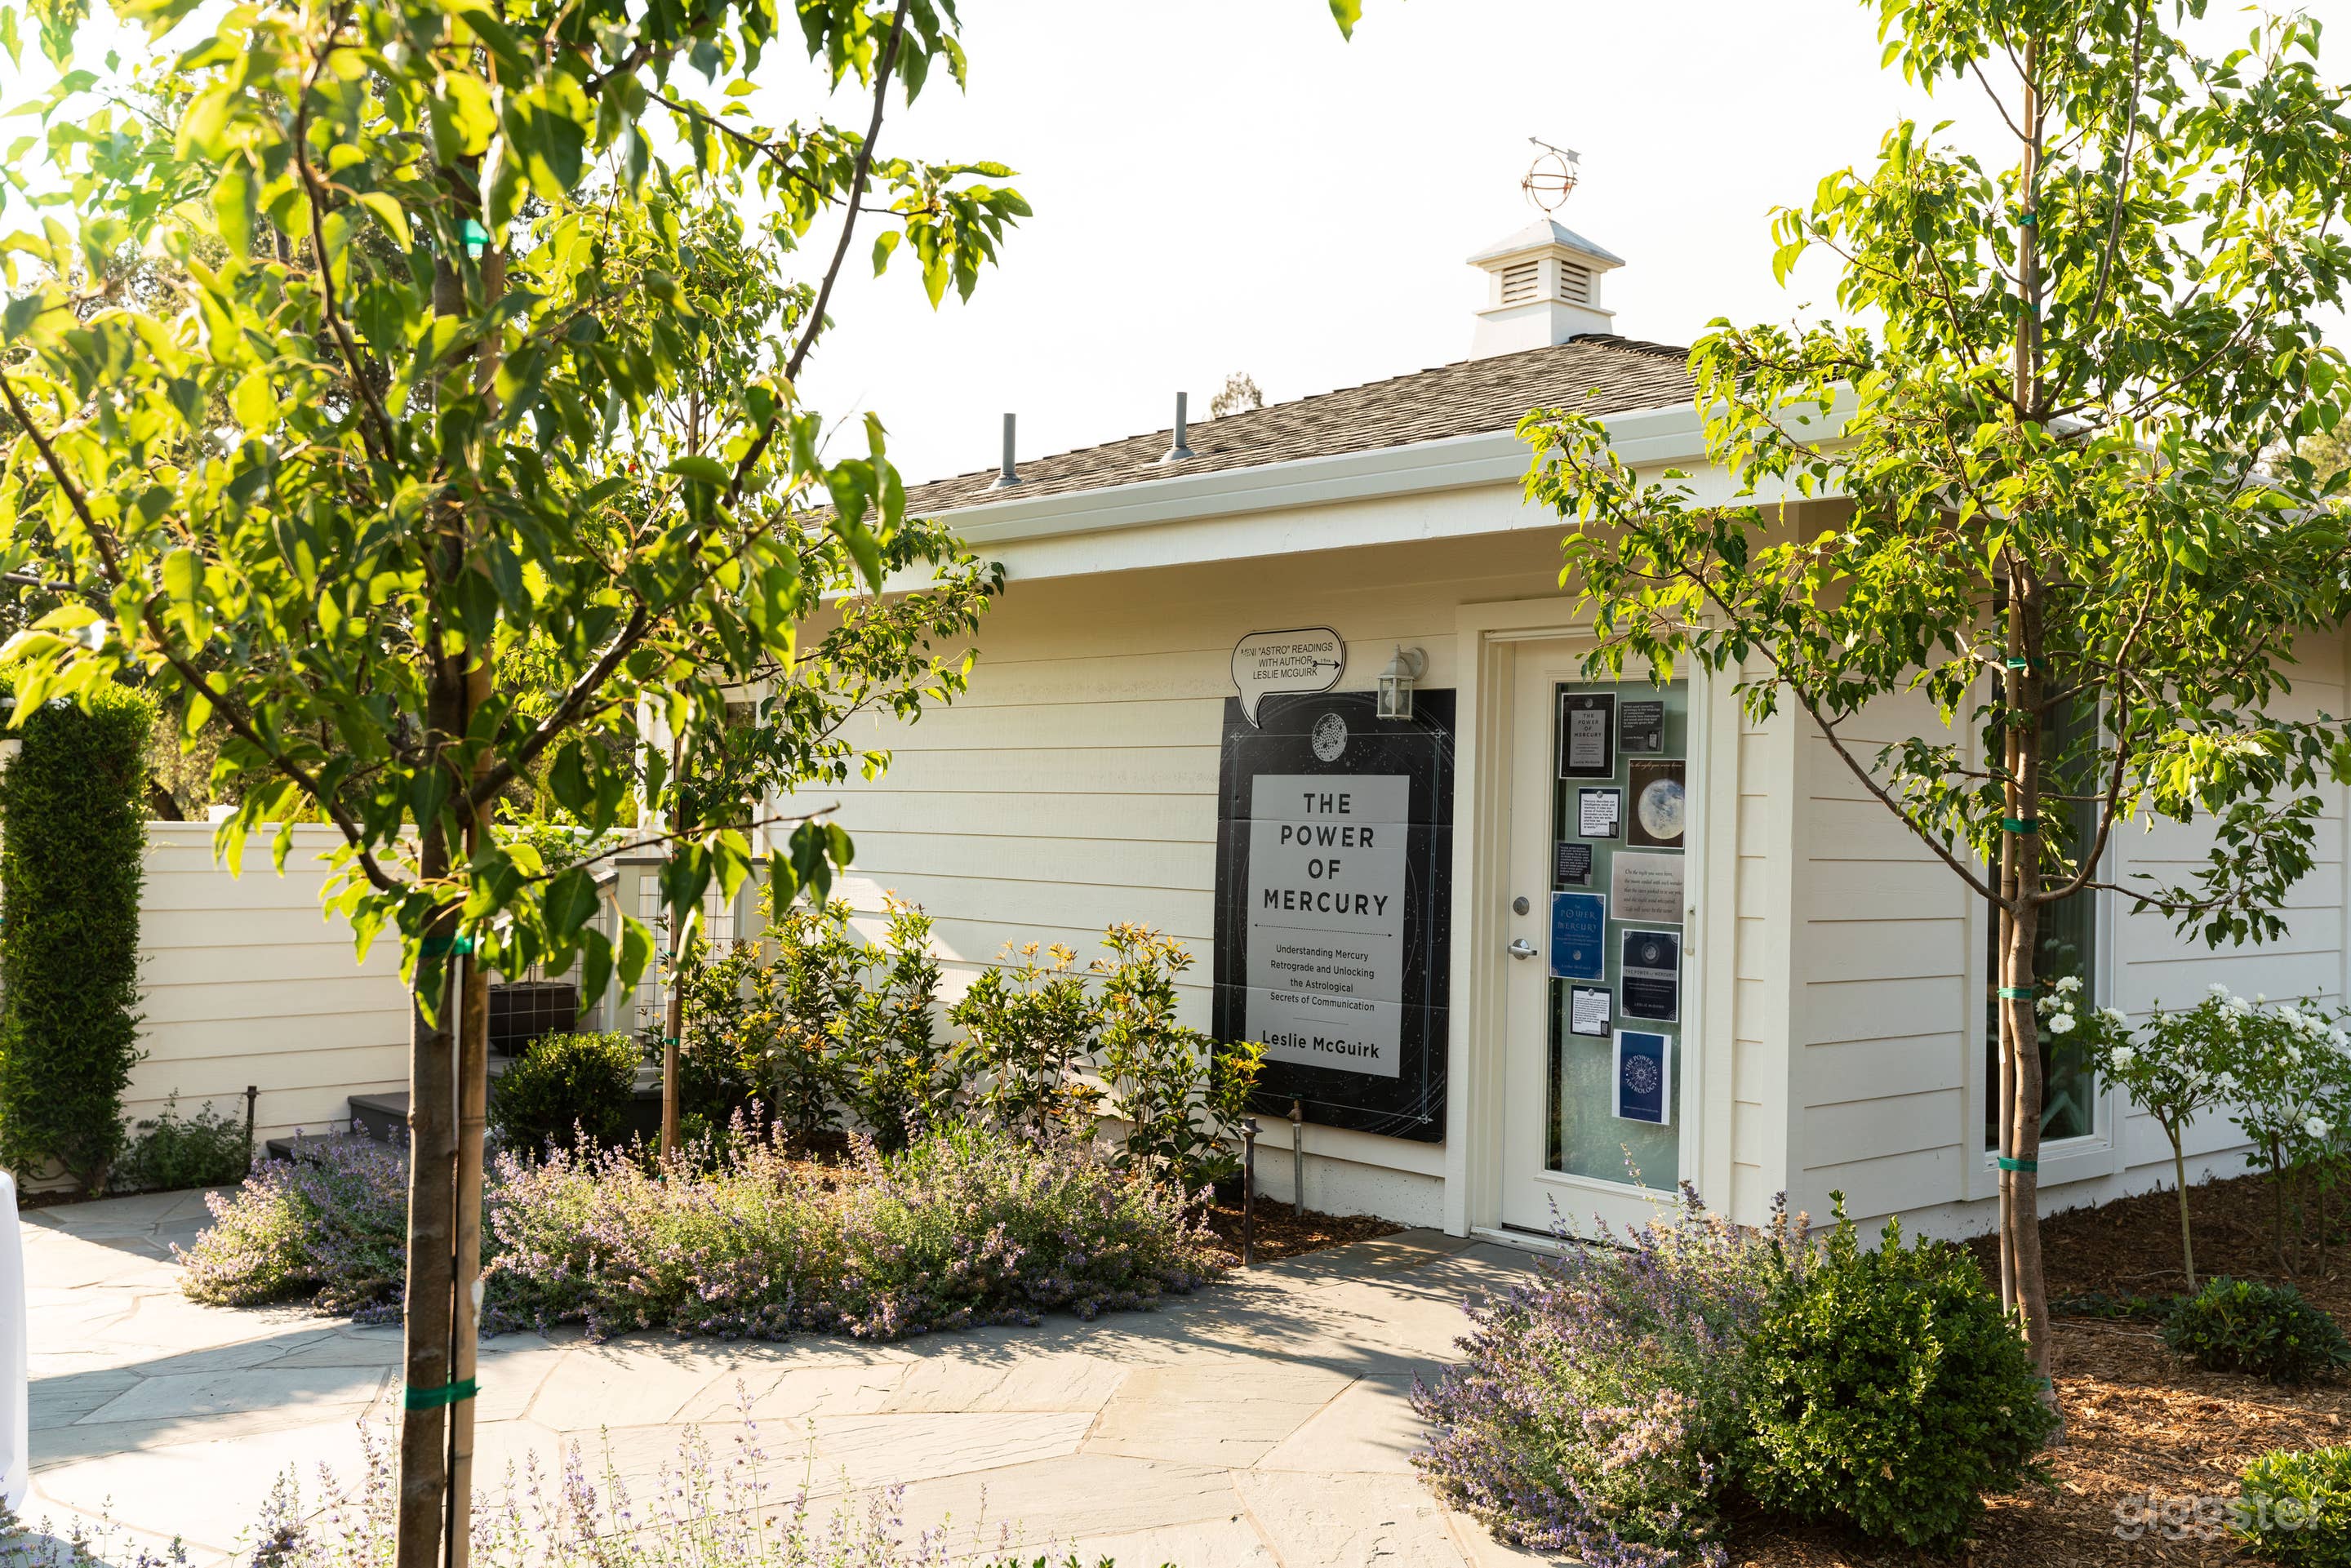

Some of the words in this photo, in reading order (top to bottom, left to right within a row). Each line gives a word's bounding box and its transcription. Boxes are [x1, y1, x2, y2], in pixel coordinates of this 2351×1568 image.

[1259, 646, 1290, 655] "ASTRO"
[1292, 642, 1333, 654] READINGS
[1259, 658, 1278, 668] WITH
[1279, 655, 1313, 666] AUTHOR
[1253, 669, 1278, 680] LESLIE
[1281, 667, 1318, 678] MCGUIRK
[1303, 793, 1352, 815] THE
[1280, 824, 1375, 848] POWER
[1307, 858, 1341, 880] OF
[1264, 888, 1389, 917] MERCURY
[1560, 908, 1598, 920] POWER
[1558, 922, 1597, 932] MERCURY
[1275, 944, 1334, 959] Understanding
[1335, 949, 1369, 962] Mercury
[1270, 960, 1314, 975] Retrograde
[1316, 963, 1331, 975] and
[1333, 966, 1375, 979] Unlocking
[1290, 978, 1304, 988] the
[1305, 979, 1353, 993] Astrological
[1269, 992, 1300, 1004] Secrets
[1300, 995, 1310, 1005] of
[1311, 997, 1375, 1012] Communication
[1262, 1030, 1307, 1049] Leslie
[1313, 1036, 1380, 1059] McGuirk
[1625, 1058, 1634, 1071] THE
[1633, 1055, 1654, 1066] POWER
[1651, 1065, 1658, 1074] OF
[1625, 1078, 1657, 1094] ASTROLOGY
